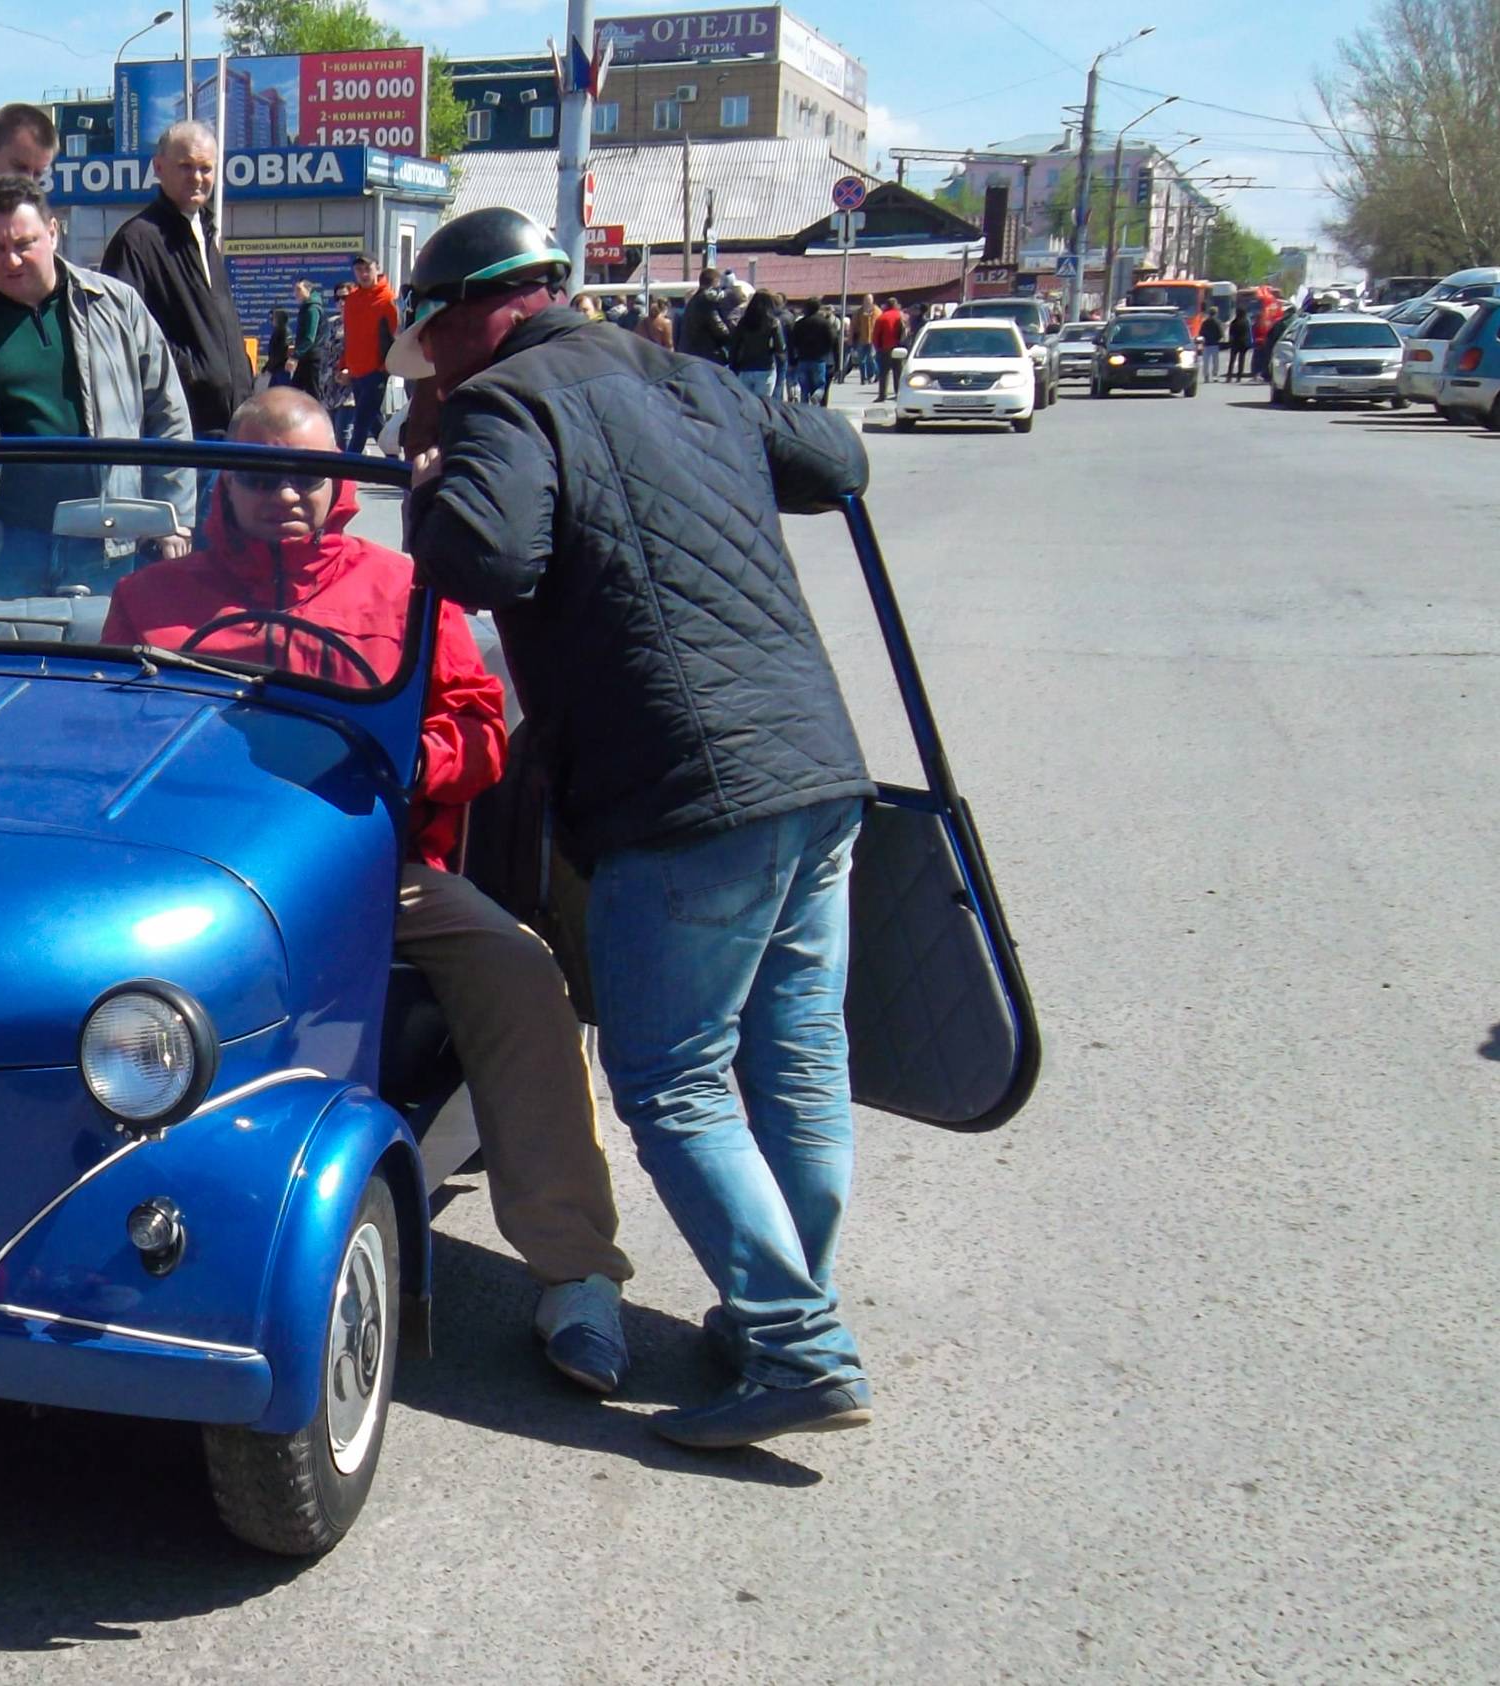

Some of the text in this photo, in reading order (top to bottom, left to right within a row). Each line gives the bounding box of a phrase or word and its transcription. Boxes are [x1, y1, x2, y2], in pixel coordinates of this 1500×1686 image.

[652, 13, 768, 42] ОТЕЛЬ
[691, 42, 736, 55] этаж
[322, 60, 407, 72] 1-комнатная:
[317, 79, 327, 101] 1
[332, 79, 371, 100] 300
[375, 77, 415, 98] 000
[320, 110, 405, 122] 2-комнатная:
[316, 126, 414, 147] 1 825 000
[227, 240, 360, 251] АВТОМОБИЛЬНАЯ ПАРКОВКА
